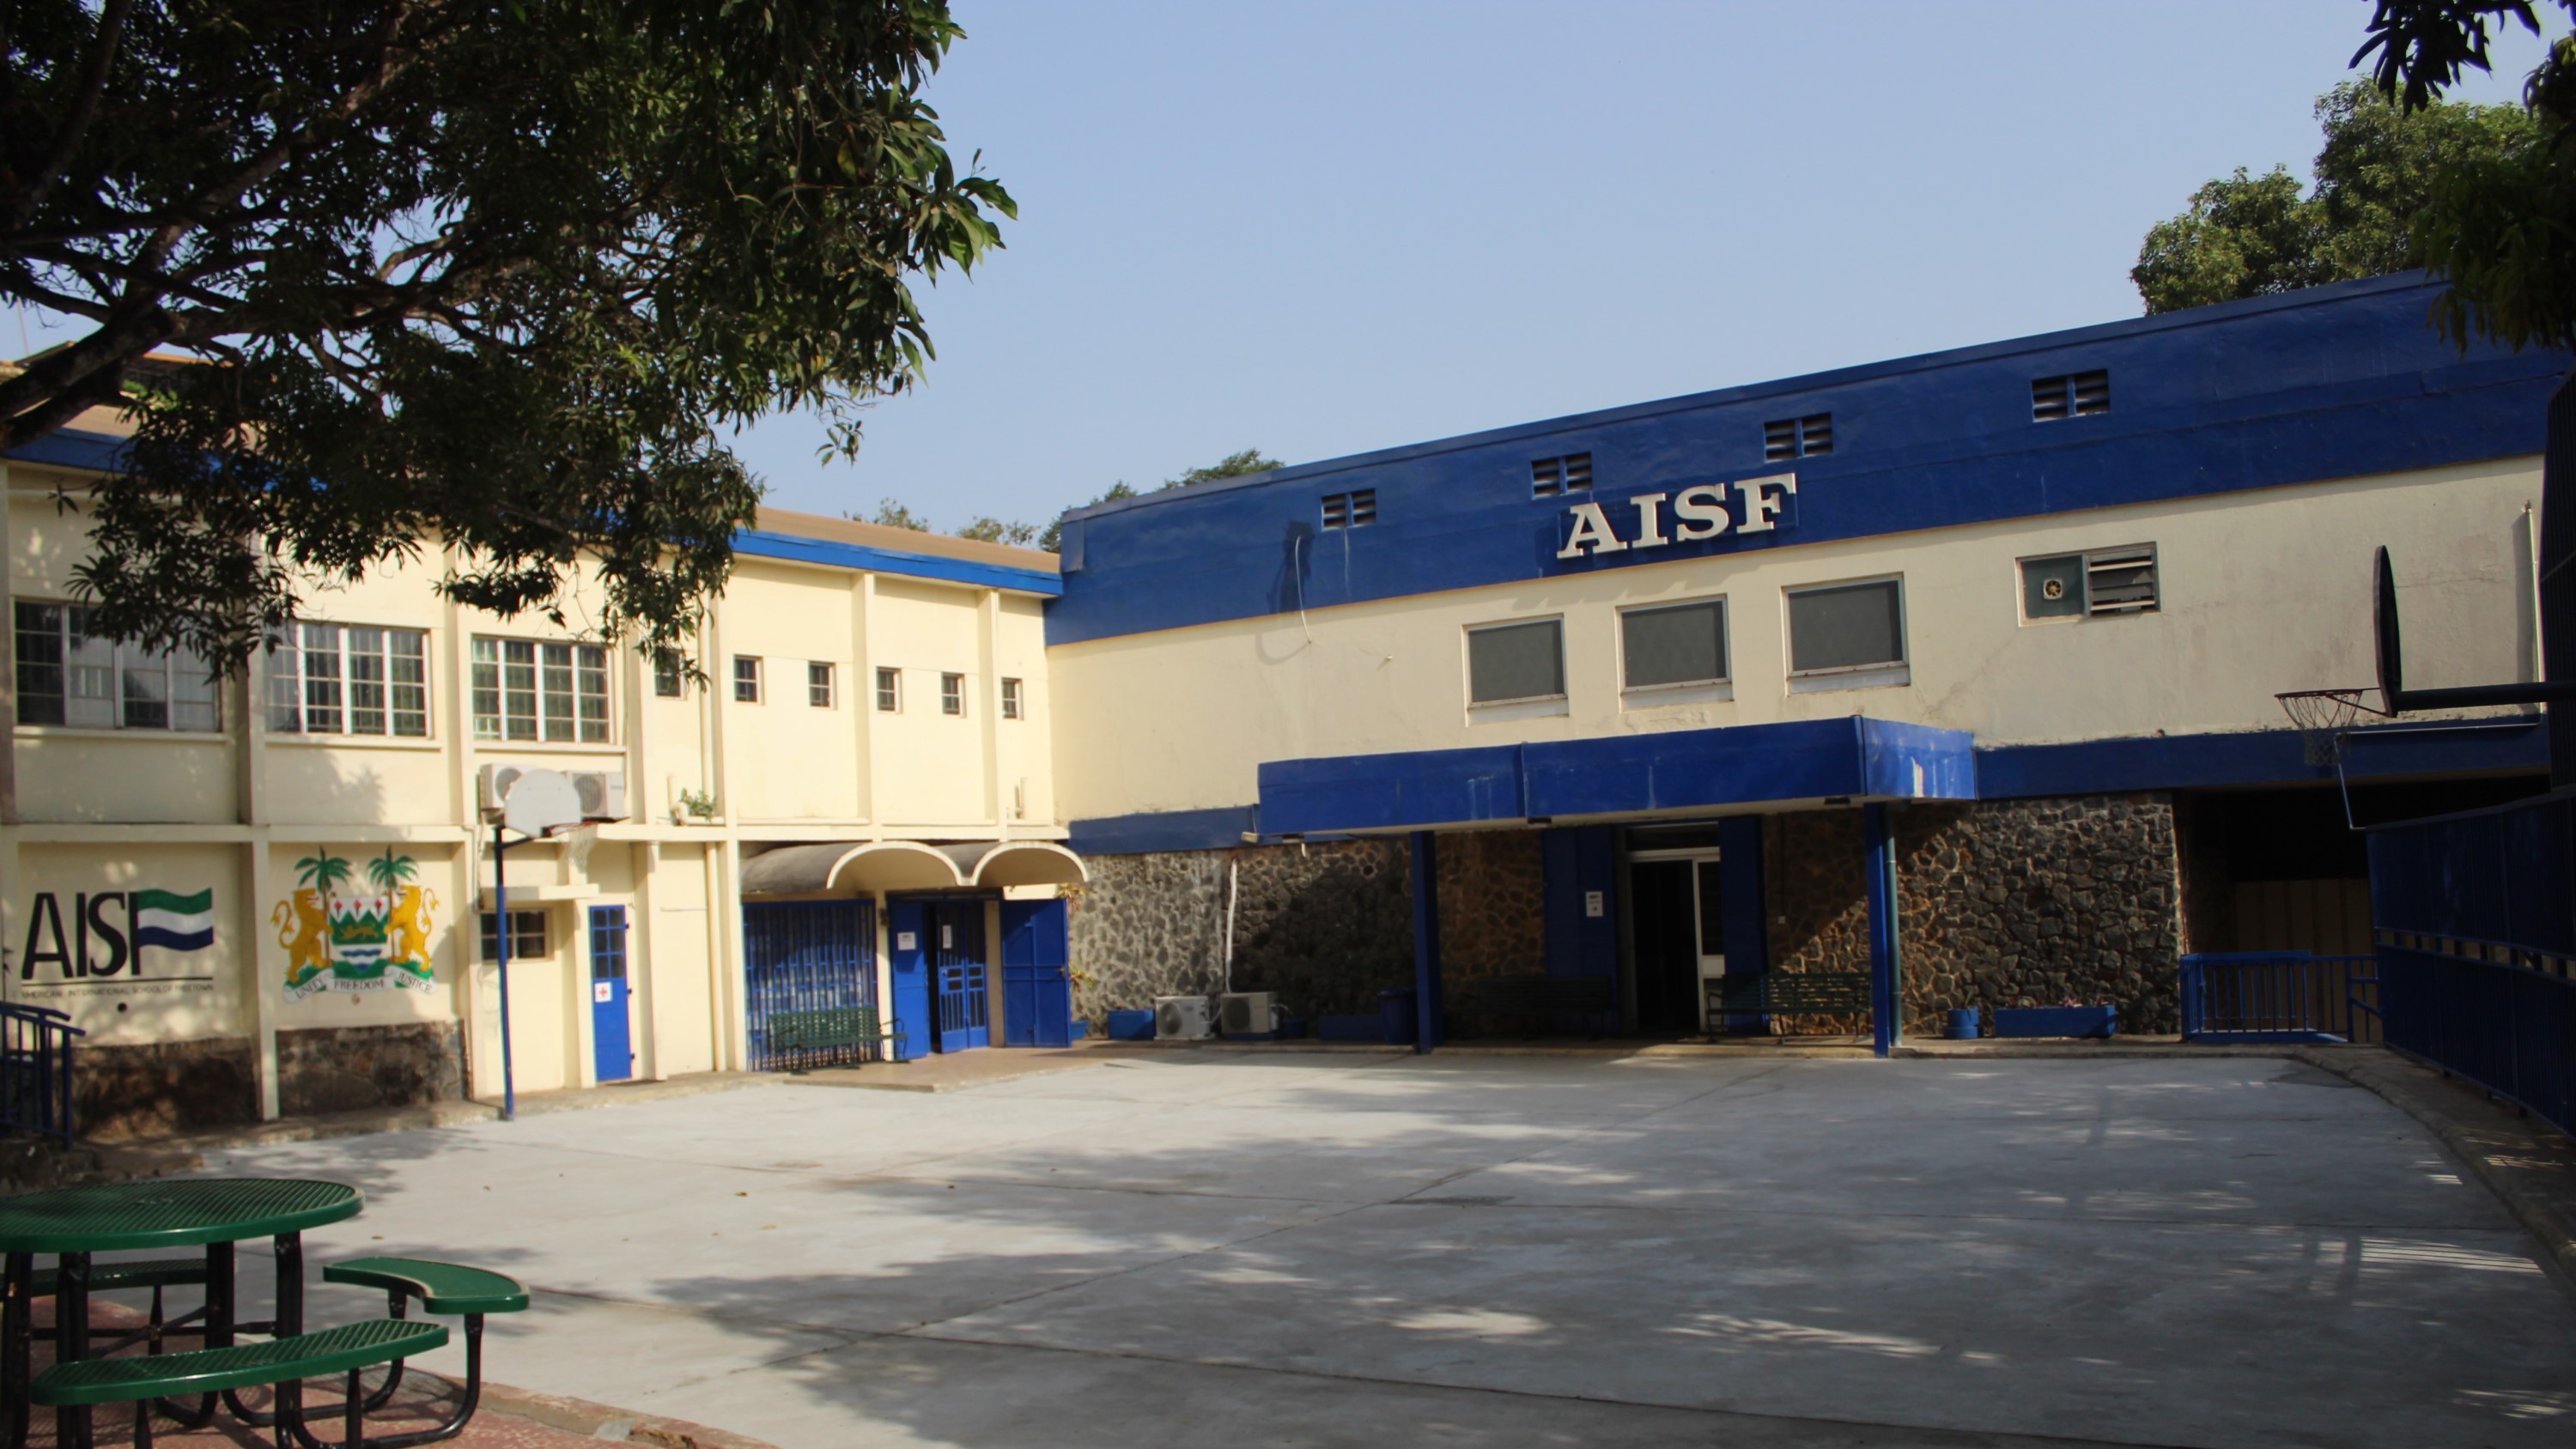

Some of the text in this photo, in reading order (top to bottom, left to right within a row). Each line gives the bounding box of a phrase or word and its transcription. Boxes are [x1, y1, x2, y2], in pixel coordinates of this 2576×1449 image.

[1556, 472, 1797, 560] AISF
[295, 977, 324, 999] UNITY
[333, 979, 385, 989] FREEDOM
[398, 972, 433, 992] JUSTICE
